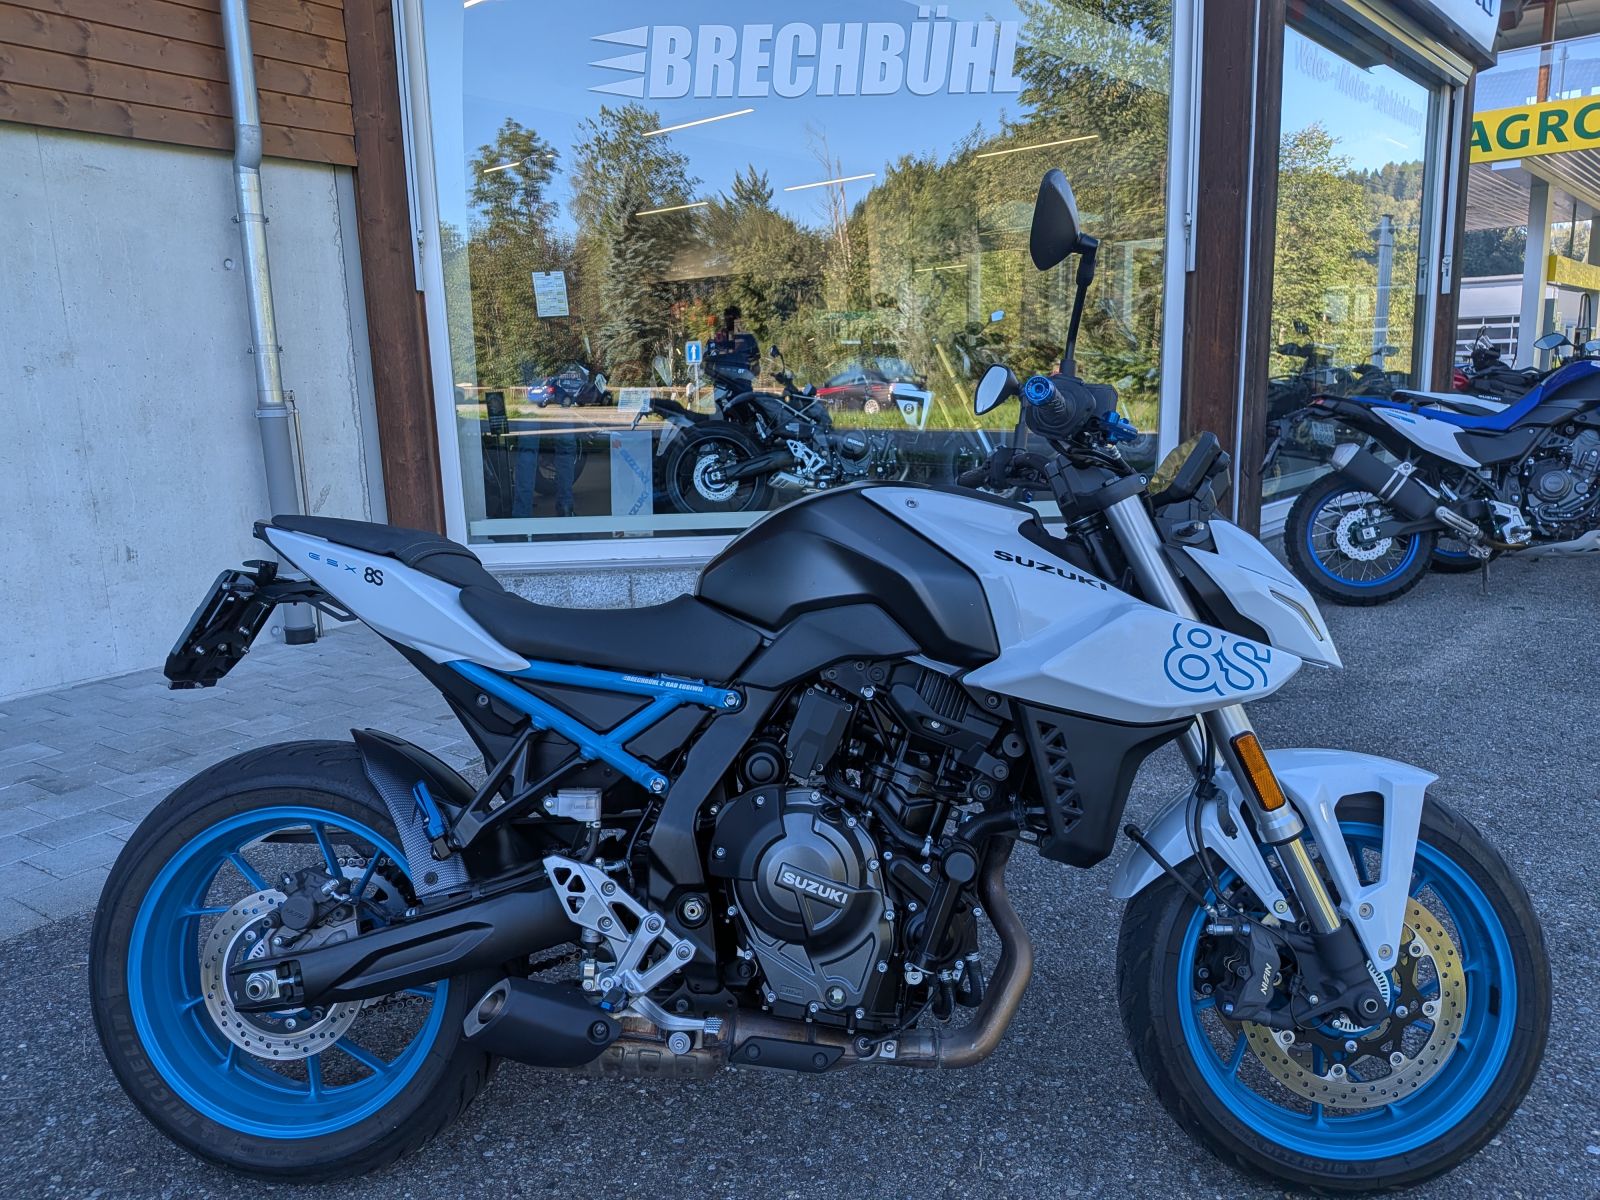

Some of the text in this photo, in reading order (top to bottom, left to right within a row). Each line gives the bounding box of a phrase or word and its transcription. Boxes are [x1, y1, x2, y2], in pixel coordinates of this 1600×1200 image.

[649, 5, 1021, 98] BRECHBÜHL
[993, 550, 1108, 592] SUZUKI
[1163, 622, 1272, 696] 8S
[781, 871, 849, 905] SUZUKI
[1260, 962, 1273, 996] NISSIN
[112, 1012, 199, 1128] MICHELIN
